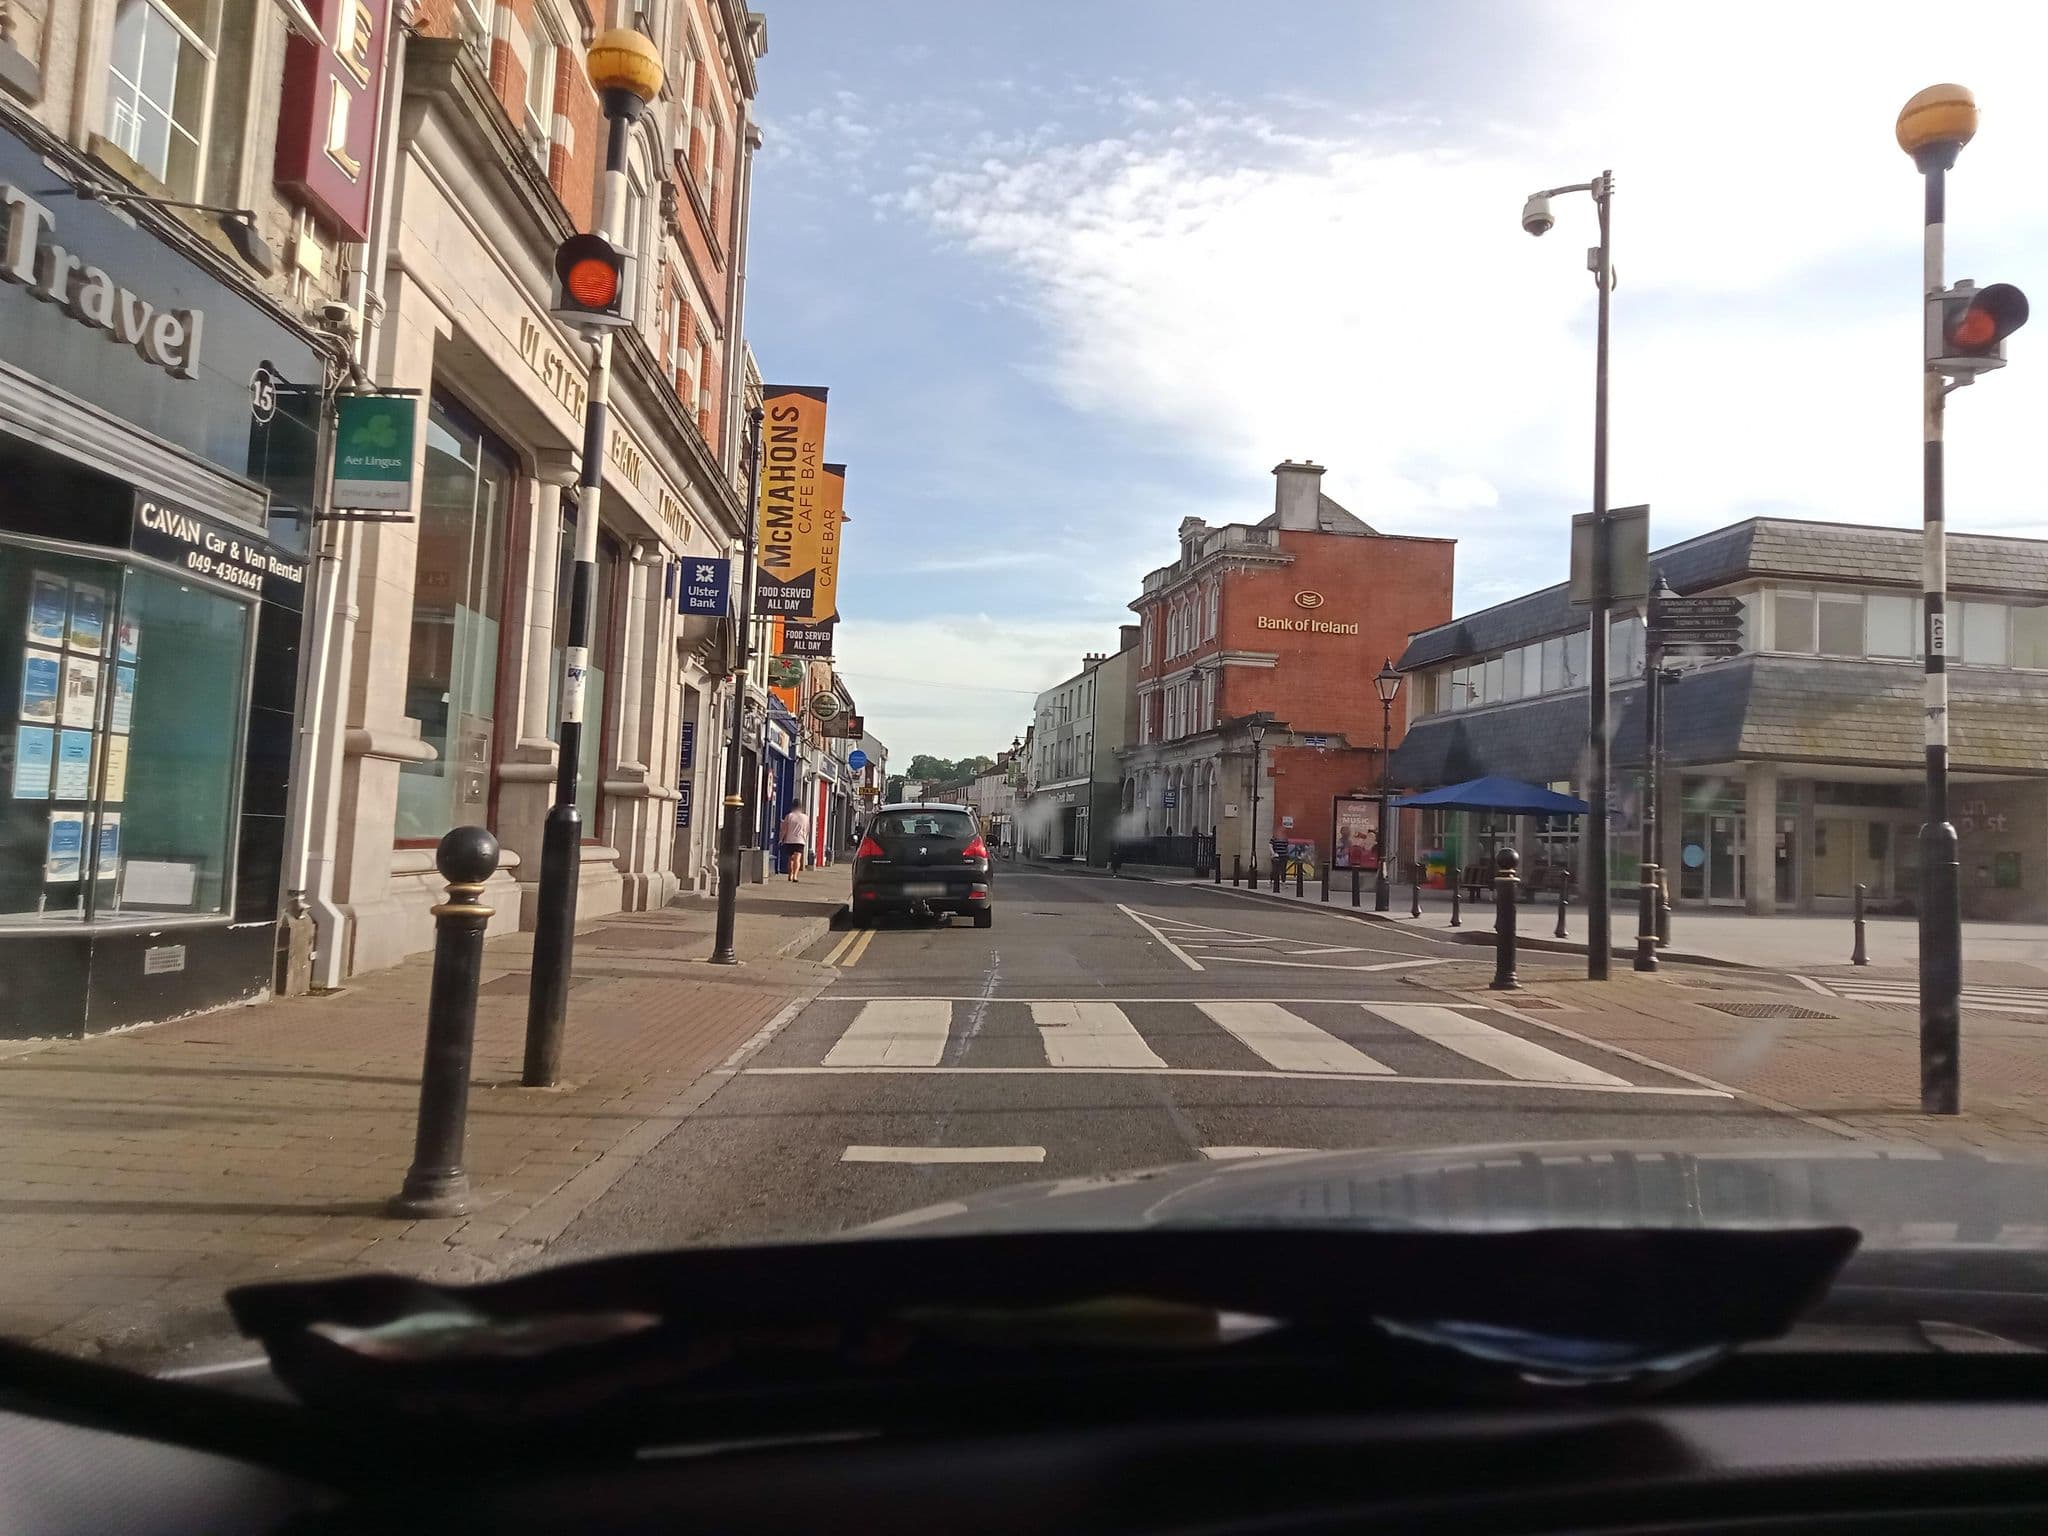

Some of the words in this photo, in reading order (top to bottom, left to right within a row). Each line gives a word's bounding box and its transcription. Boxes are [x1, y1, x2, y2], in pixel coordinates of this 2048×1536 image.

[0, 184, 204, 380] Travel
[253, 381, 274, 411] 15
[520, 316, 586, 424] ULSTER
[611, 430, 644, 490] BANK
[657, 488, 692, 546] LIMITED
[344, 455, 363, 465] Aer
[365, 456, 402, 469] Lingus
[801, 442, 816, 479] BAR
[798, 485, 815, 534] CAFE
[823, 508, 836, 541] BAR
[141, 502, 201, 545] CAVAN
[205, 532, 228, 554] Car
[230, 541, 240, 561] &
[244, 546, 266, 569] Van
[268, 556, 303, 583] Rental
[187, 551, 264, 592] 049-4361441
[819, 546, 834, 587] CAFE
[688, 586, 719, 597] Ulster
[690, 598, 715, 608] Bank
[758, 586, 779, 598] FOOD
[780, 587, 811, 599] SERVED
[767, 598, 782, 610] ALL
[784, 599, 801, 610] DAY
[786, 630, 804, 640] FOOD
[804, 631, 831, 642] SERVED
[1257, 616, 1293, 631] Bank
[1294, 619, 1311, 632] of
[1311, 619, 1359, 635] Ireland
[794, 640, 806, 650] ALL
[808, 641, 822, 651] DAY
[1342, 816, 1369, 824] MUSIC
